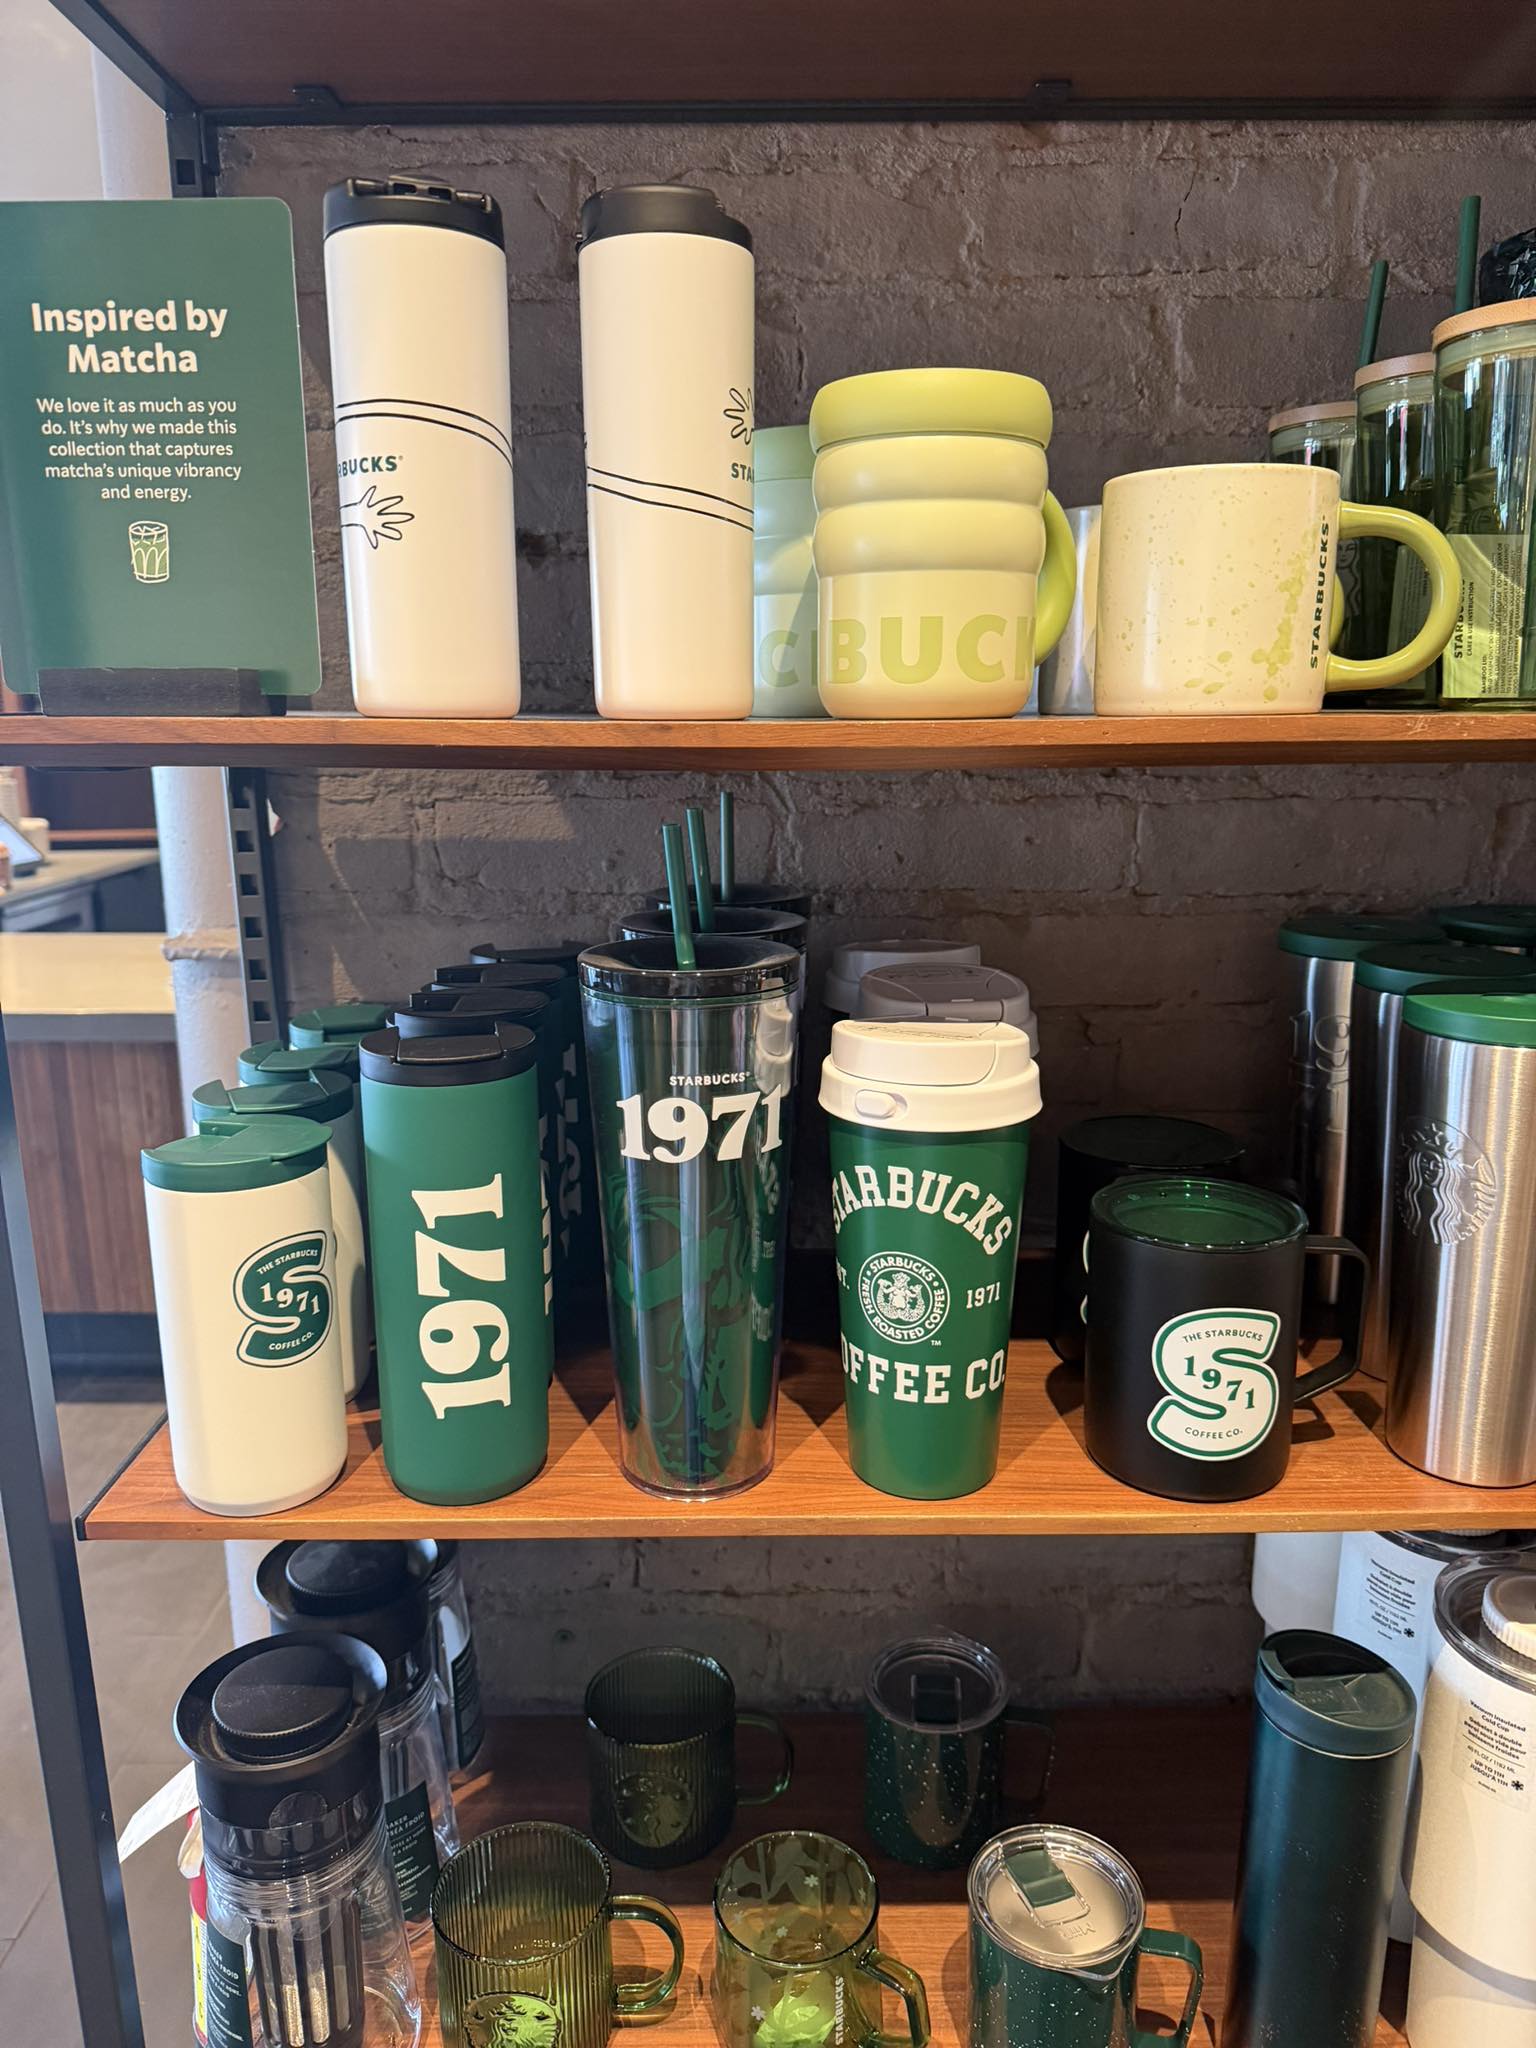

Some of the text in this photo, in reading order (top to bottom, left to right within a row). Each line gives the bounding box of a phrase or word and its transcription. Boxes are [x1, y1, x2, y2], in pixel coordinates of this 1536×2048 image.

[31, 300, 228, 338] Inspired by
[68, 342, 198, 373] Matcha
[36, 397, 237, 416] We love it as much as you
[41, 420, 66, 435] do.
[96, 419, 128, 438] why
[132, 422, 155, 434] we
[159, 419, 204, 434] made
[207, 419, 237, 434] this
[49, 441, 234, 459] collection that captures
[118, 464, 172, 480] unique
[175, 463, 242, 481] vibrancy
[731, 462, 754, 484] STA
[101, 484, 192, 502] and energy.
[1310, 522, 1329, 669] STARBUCKS
[669, 1072, 745, 1086] STARBUCKS
[616, 1084, 783, 1164] 1971
[256, 1249, 318, 1275] THE STARBUCKS
[869, 1257, 936, 1282] STARBUCKS
[260, 1282, 320, 1315] 1971
[411, 1173, 511, 1419] 1971
[966, 1281, 1000, 1310] 1971
[862, 1277, 945, 1340] FRESH ROASTED COFFEE
[268, 1338, 300, 1351] COFFEE
[1183, 1329, 1264, 1343] THE STARBUCKS
[1183, 1355, 1255, 1410] 1971
[1184, 1426, 1223, 1440] COFFEE
[1481, 1714, 1510, 1732] Cold Cup
[835, 1976, 845, 2046] STARBUCKS
